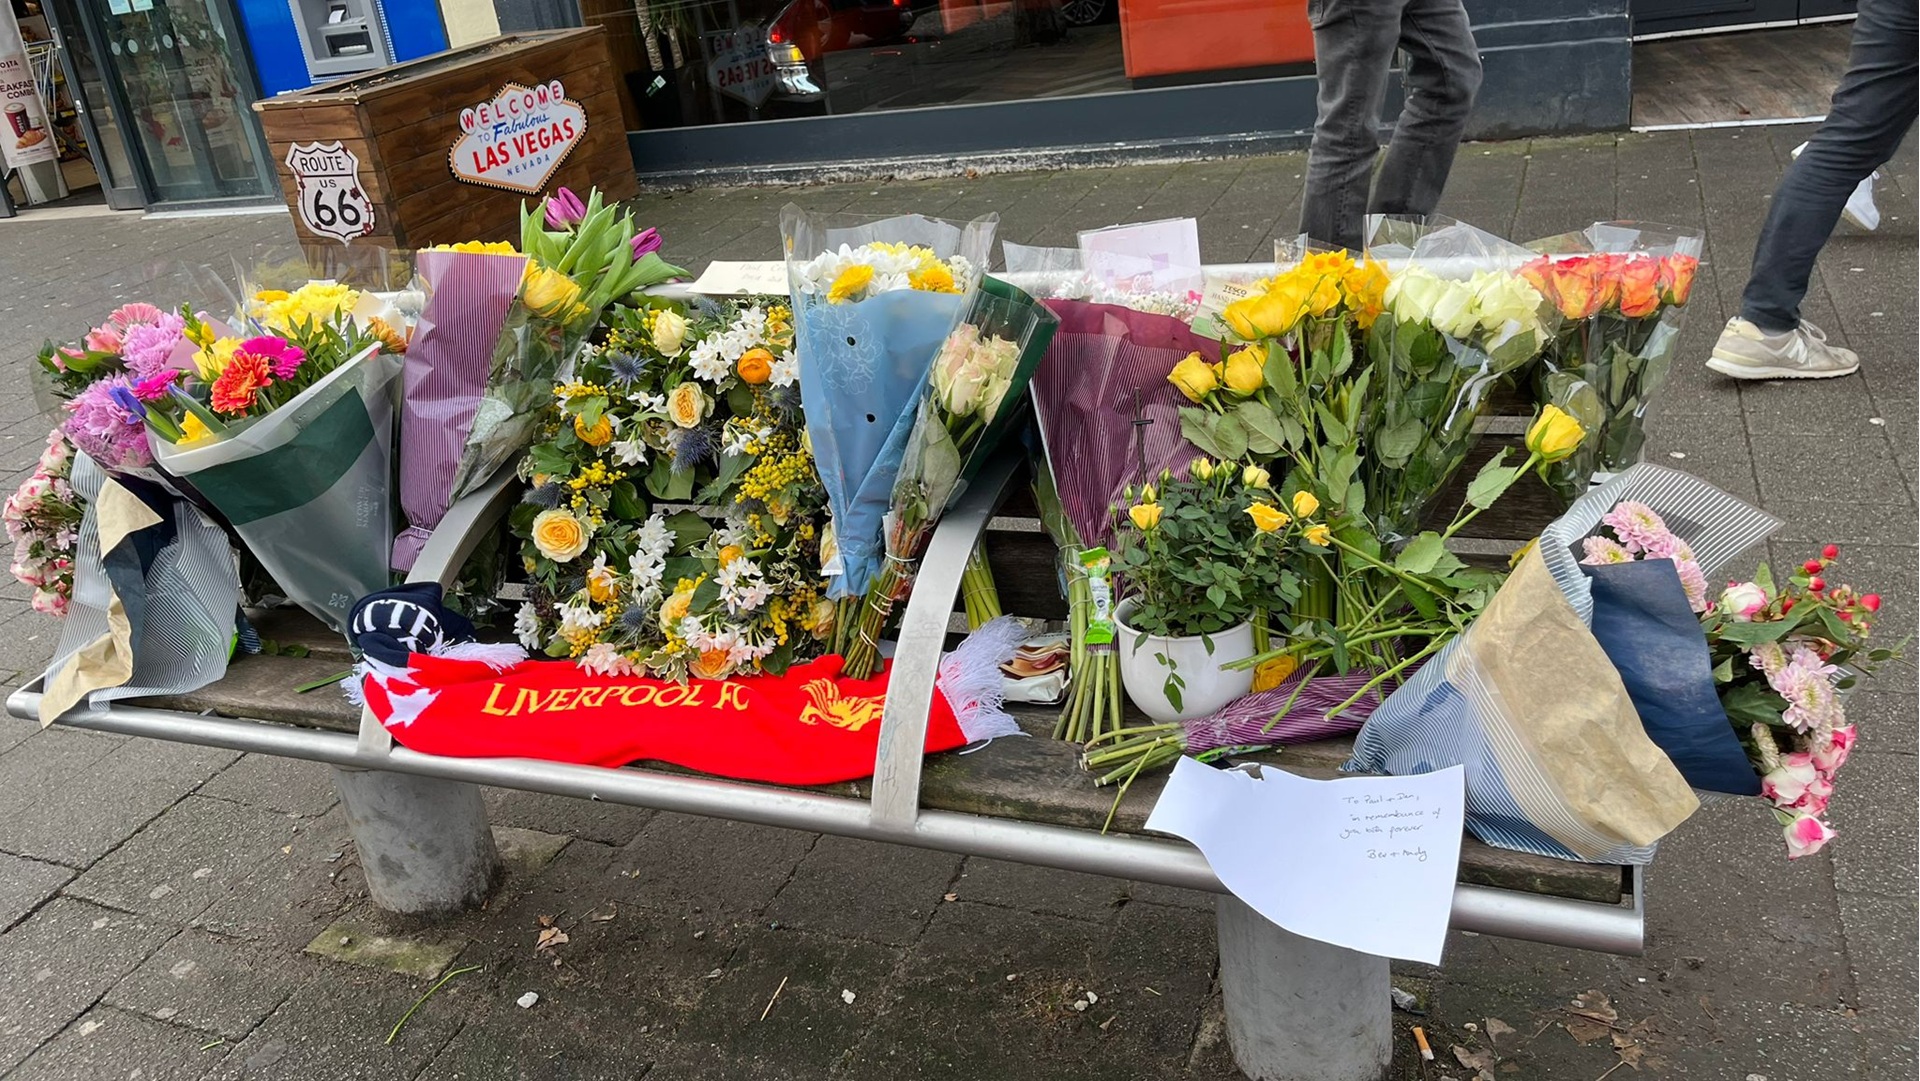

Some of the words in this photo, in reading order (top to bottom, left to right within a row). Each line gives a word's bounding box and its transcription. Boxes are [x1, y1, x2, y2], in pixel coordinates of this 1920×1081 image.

[462, 84, 561, 130] WELCOME
[478, 132, 491, 143] TO
[492, 113, 550, 143] Fabulous
[472, 141, 510, 174] LAS
[512, 118, 575, 158] VEGAS
[300, 156, 345, 172] ROUTE
[506, 154, 551, 176] NEVADA
[319, 179, 337, 188] US
[314, 189, 361, 226] 66
[1223, 285, 1247, 297] TESCO
[481, 682, 705, 716] LIVERPOOL
[712, 681, 750, 711] FC
[1342, 796, 1359, 804] To
[1363, 794, 1383, 804] Paul
